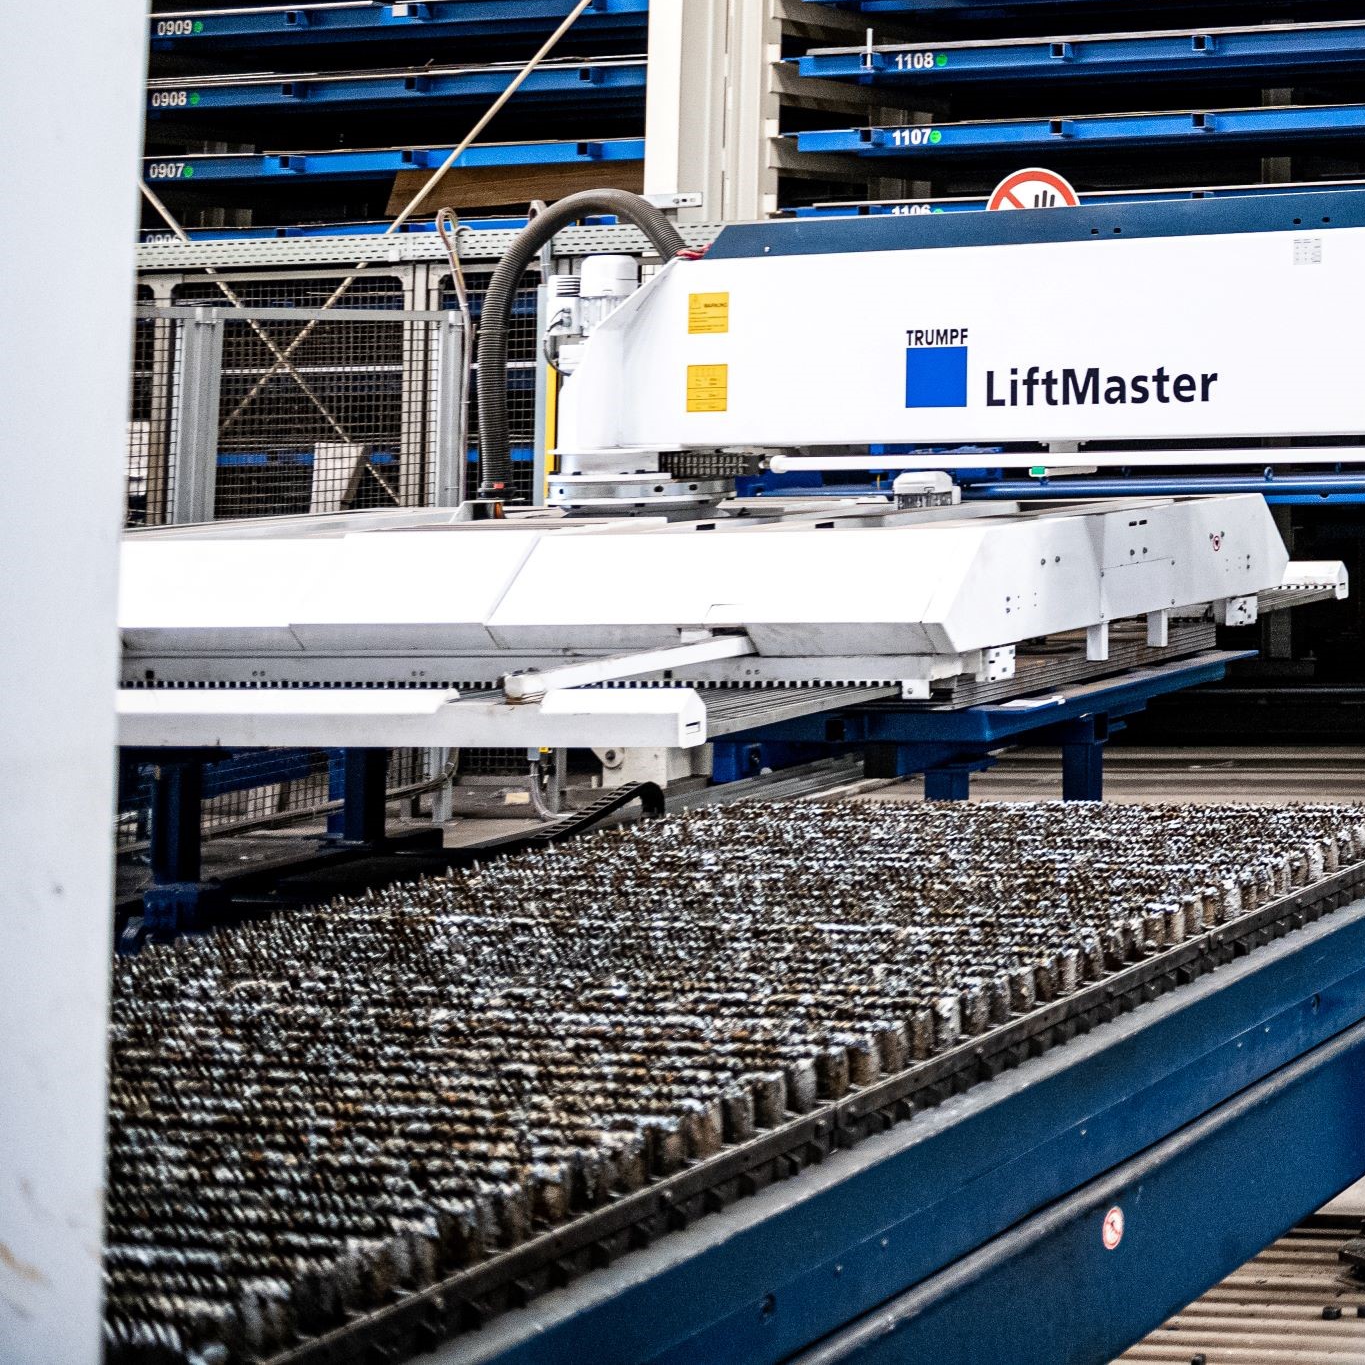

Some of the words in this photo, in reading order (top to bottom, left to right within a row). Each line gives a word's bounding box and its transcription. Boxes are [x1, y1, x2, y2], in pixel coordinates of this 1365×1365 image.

[157, 20, 192, 36] 0909
[895, 52, 934, 70] 1108
[152, 91, 187, 107] 0908
[892, 128, 931, 146] 1107
[149, 163, 184, 178] 0907
[906, 328, 968, 346] TRUMPF
[986, 366, 1218, 407] LiftMaster
